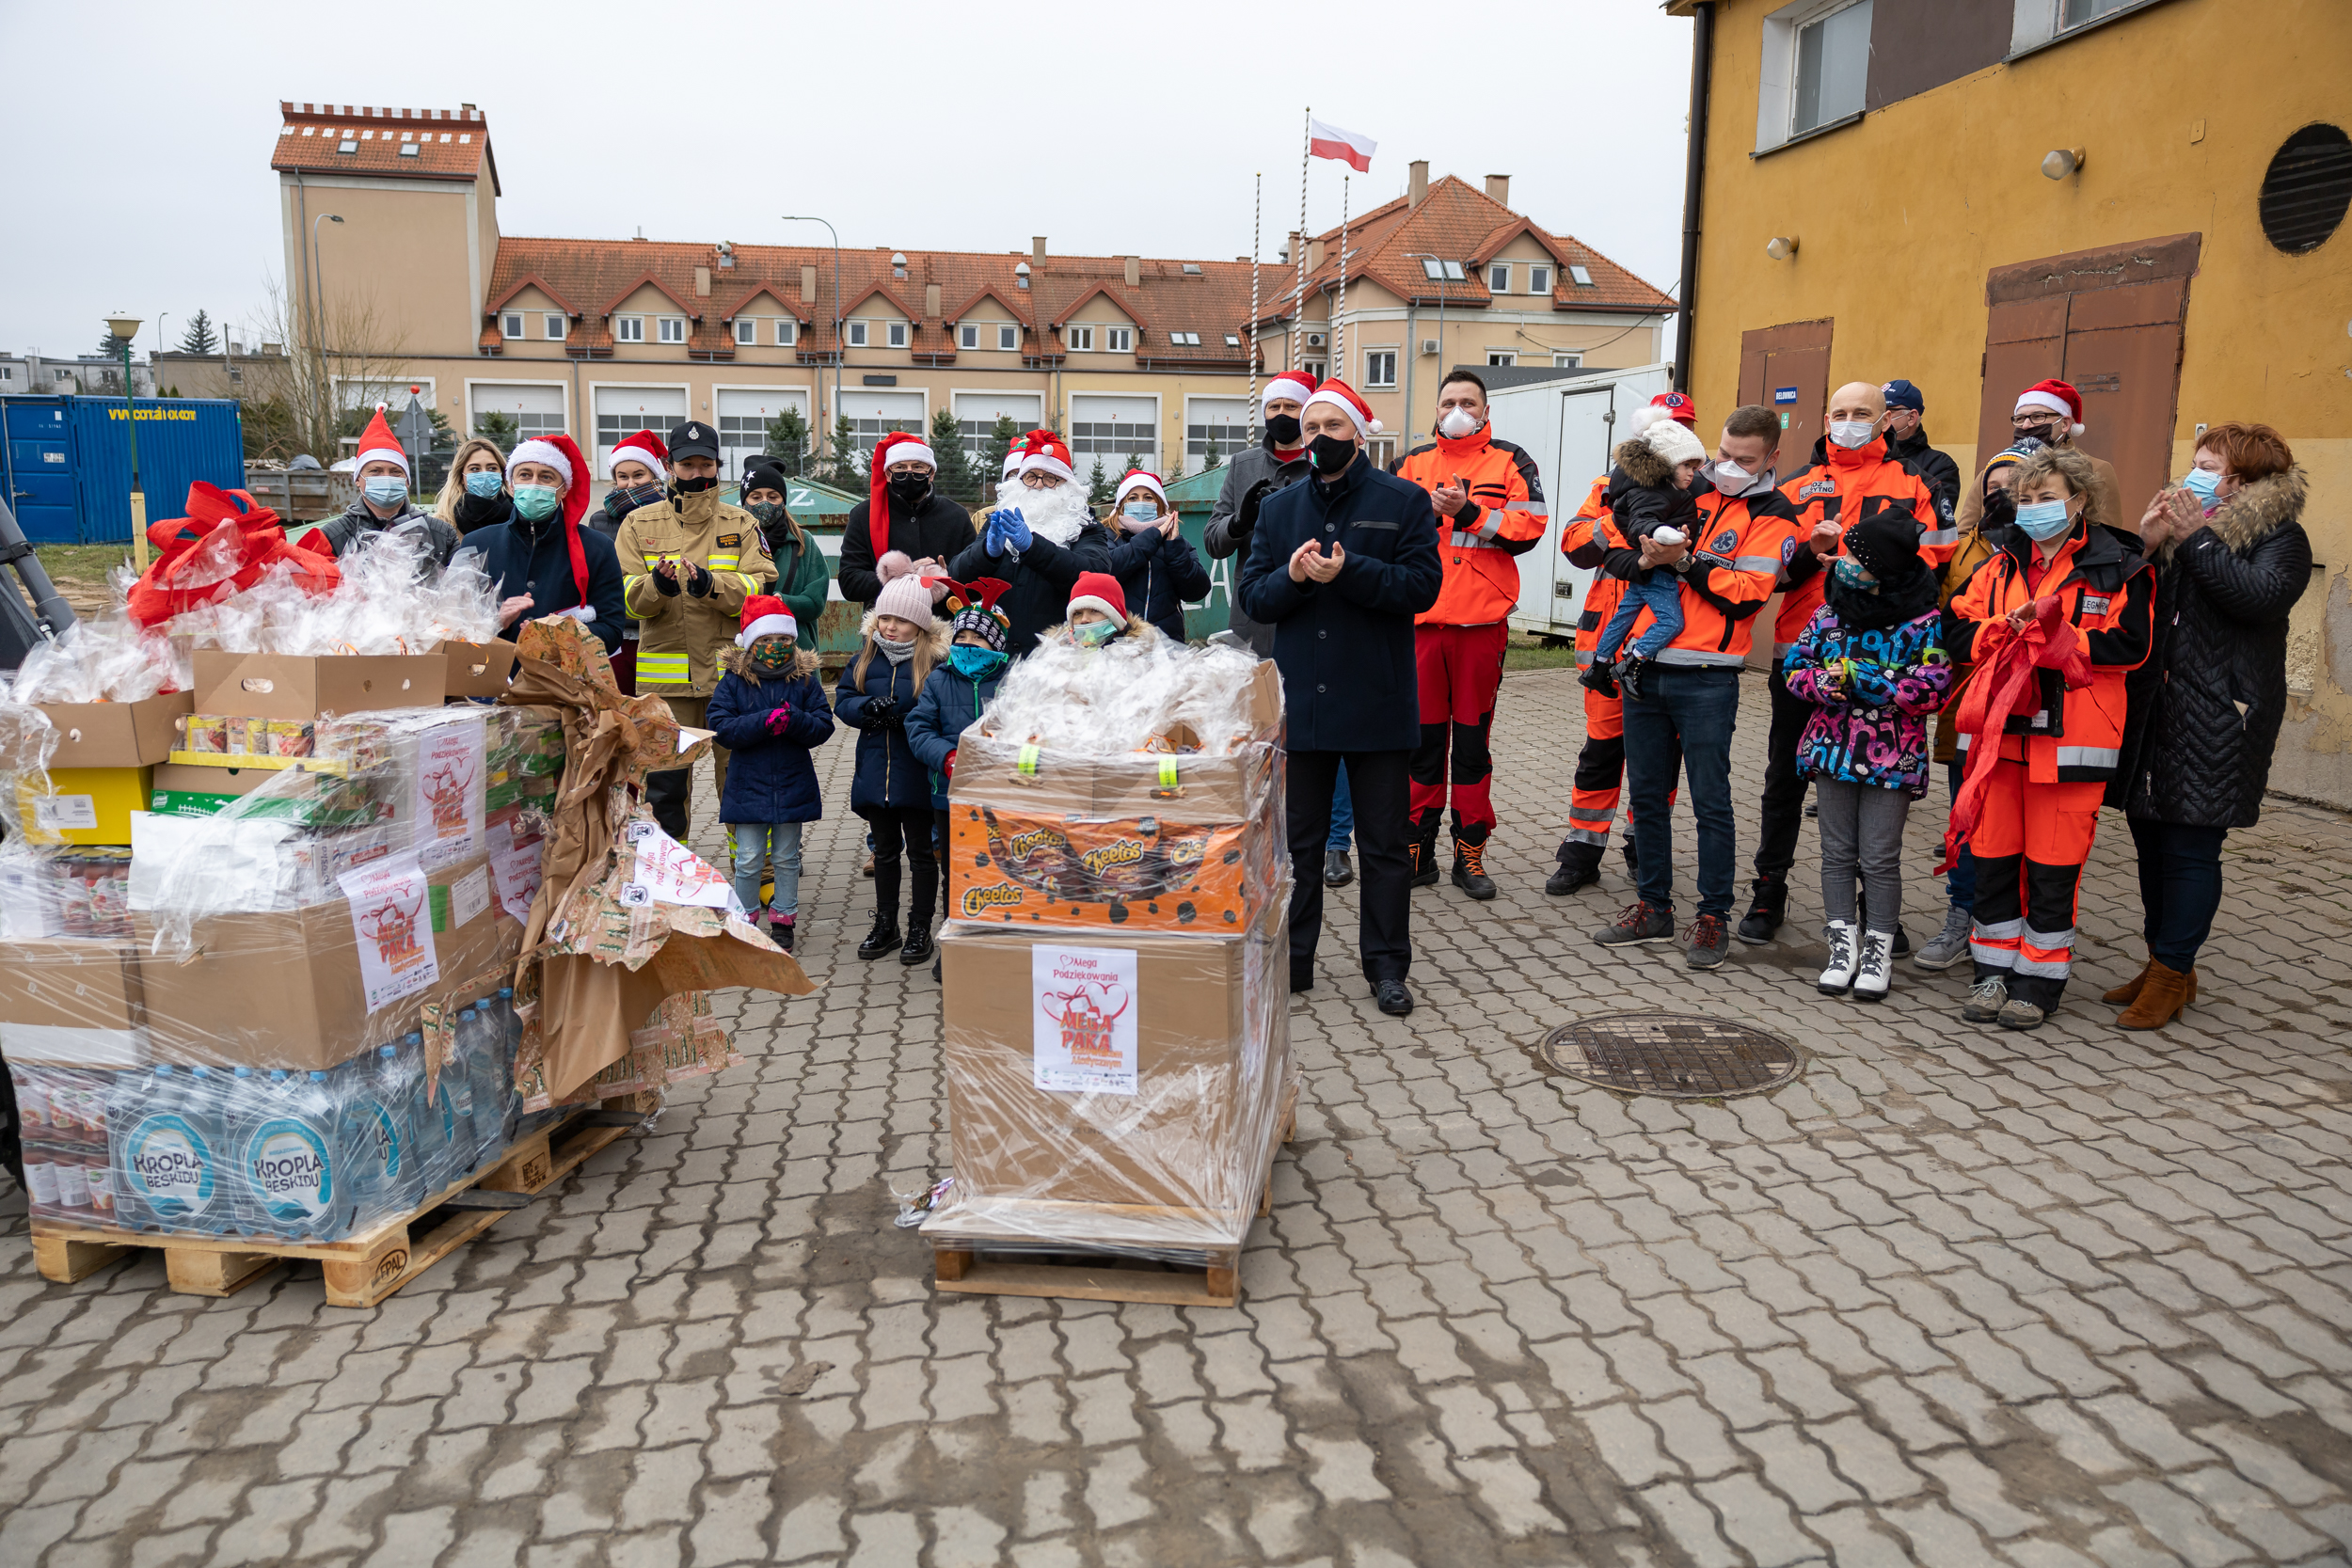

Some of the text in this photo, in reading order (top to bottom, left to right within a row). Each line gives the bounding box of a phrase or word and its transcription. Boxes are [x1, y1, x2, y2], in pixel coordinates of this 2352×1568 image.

[1696, 551, 1731, 568] RATOWNIK
[1011, 828, 1066, 862] Cheetos
[519, 854, 535, 866] Mega
[371, 869, 390, 882] Mega
[363, 876, 411, 899] Podziękowania
[963, 883, 1023, 917] Cheetos
[377, 915, 415, 944] MEGA
[379, 934, 416, 963] PAKA
[1073, 958, 1098, 969] Mega
[1053, 969, 1119, 982] Podziękowania
[1060, 1011, 1113, 1033] MEGA
[1060, 1030, 1112, 1052] PAKA
[132, 1151, 205, 1174] KROPLA
[253, 1152, 324, 1180] KROPLA
[145, 1170, 199, 1188] BESKIDU
[265, 1172, 319, 1193] BESKIDU
[379, 1254, 404, 1279] EPAL
